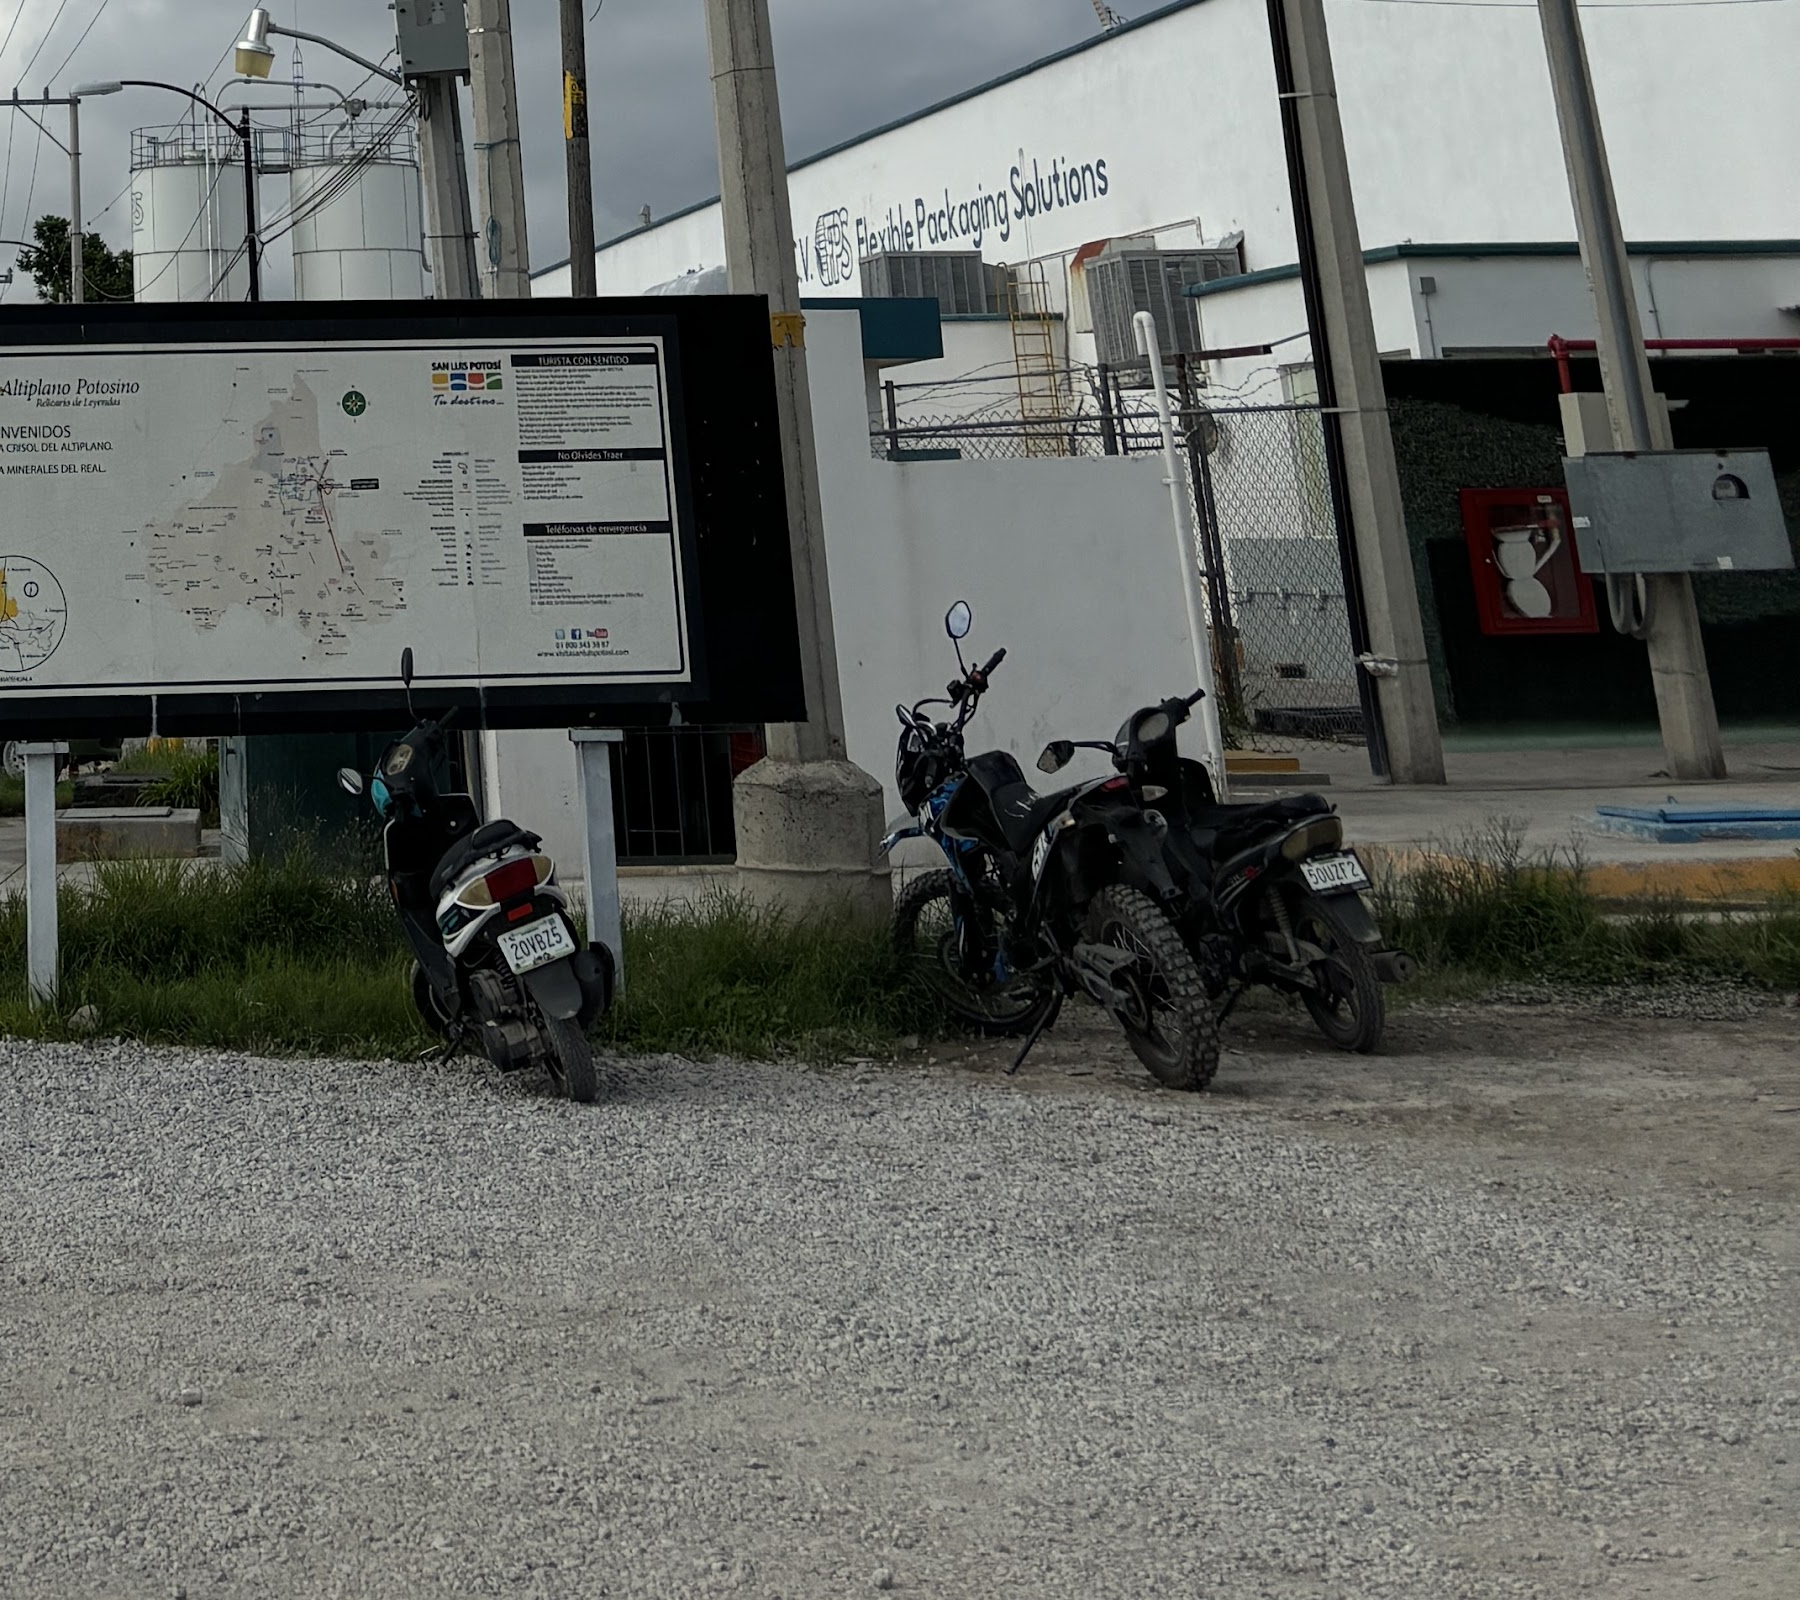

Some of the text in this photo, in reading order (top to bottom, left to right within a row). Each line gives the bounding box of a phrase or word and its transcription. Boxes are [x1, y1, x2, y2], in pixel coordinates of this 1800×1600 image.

[856, 203, 914, 258] Flexible
[914, 183, 1010, 249] Packaging
[1010, 156, 1109, 220] Solutions
[431, 361, 449, 371] SAN
[450, 361, 468, 371] LUIS
[538, 355, 630, 367] TURISTA CON SENTIDO
[0, 378, 140, 401] Altiplano Potosino
[72, 398, 82, 407] de
[83, 397, 121, 409] Leyendas
[6, 443, 39, 453] CRISOL
[41, 442, 59, 452] DEL
[557, 450, 624, 461] No Olvides Traer
[6, 464, 59, 475] MINERALES
[61, 463, 79, 474] DEL
[545, 523, 647, 535] Teléfonos de emergencia
[510, 926, 563, 961] 20VBZ5
